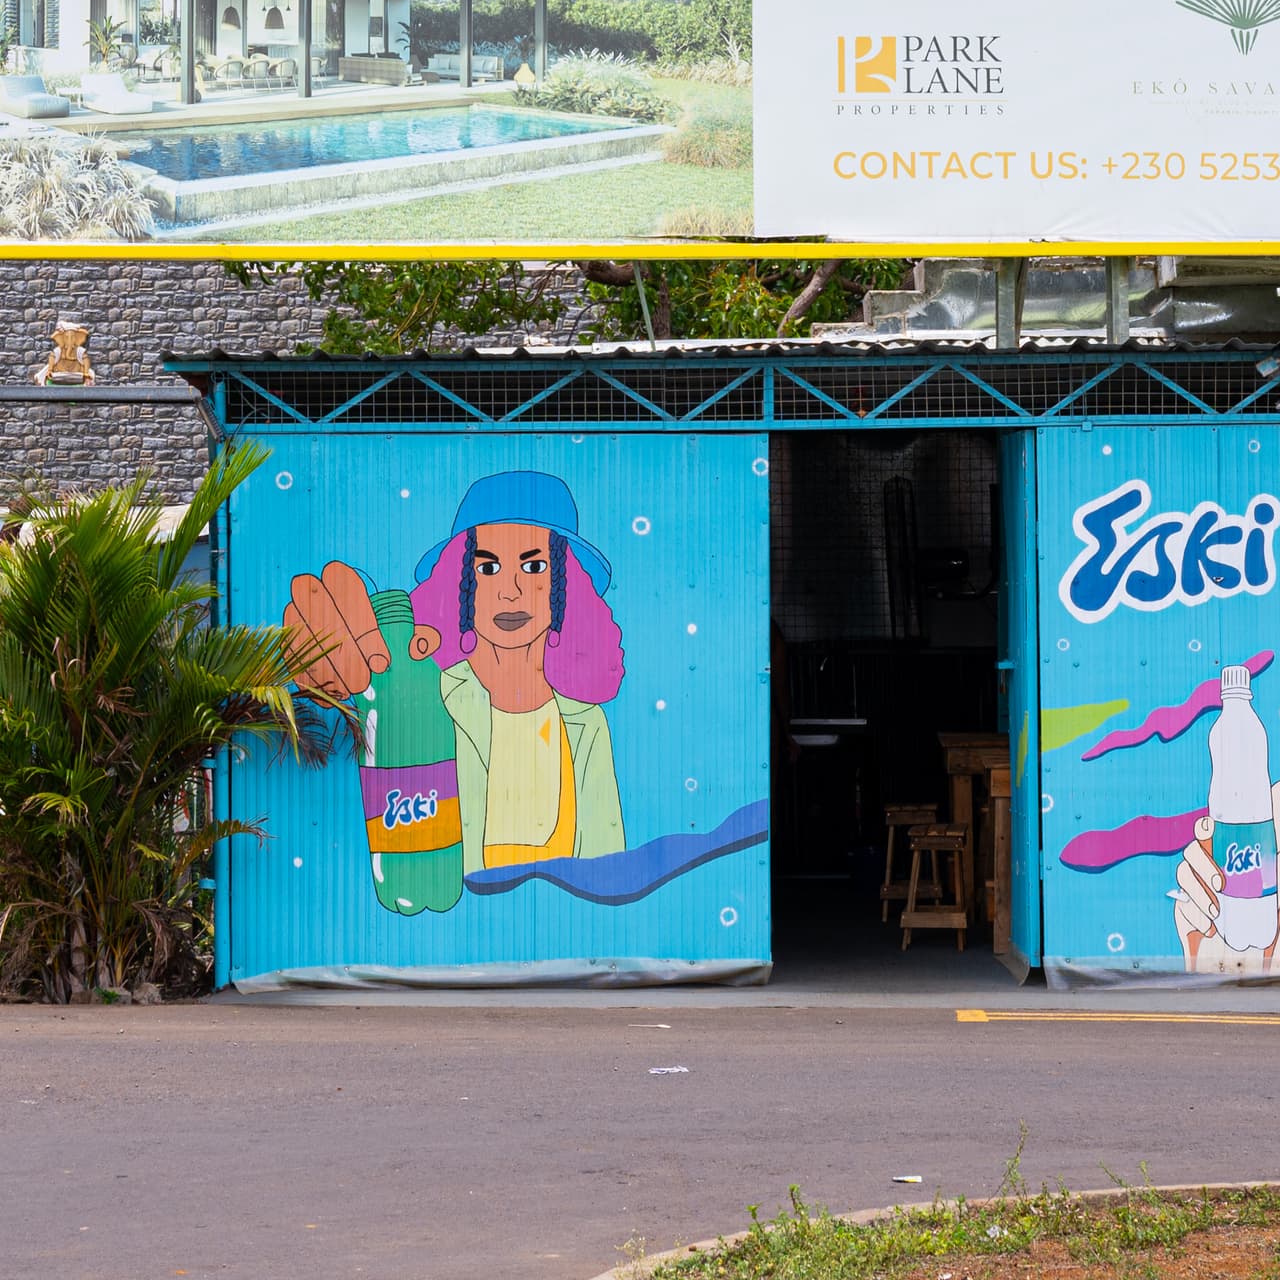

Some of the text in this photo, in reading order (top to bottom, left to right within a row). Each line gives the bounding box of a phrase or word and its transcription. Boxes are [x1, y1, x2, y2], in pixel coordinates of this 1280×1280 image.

[902, 34, 1002, 63] PARK
[903, 66, 1005, 95] LANE
[836, 104, 1006, 115] PROPERTIES
[832, 150, 1017, 180] CONTACT
[1029, 151, 1088, 180] US:
[1101, 152, 1187, 181] +230
[1064, 483, 1280, 618] Eski
[384, 790, 436, 828] Eski
[1225, 843, 1261, 874] Eski
